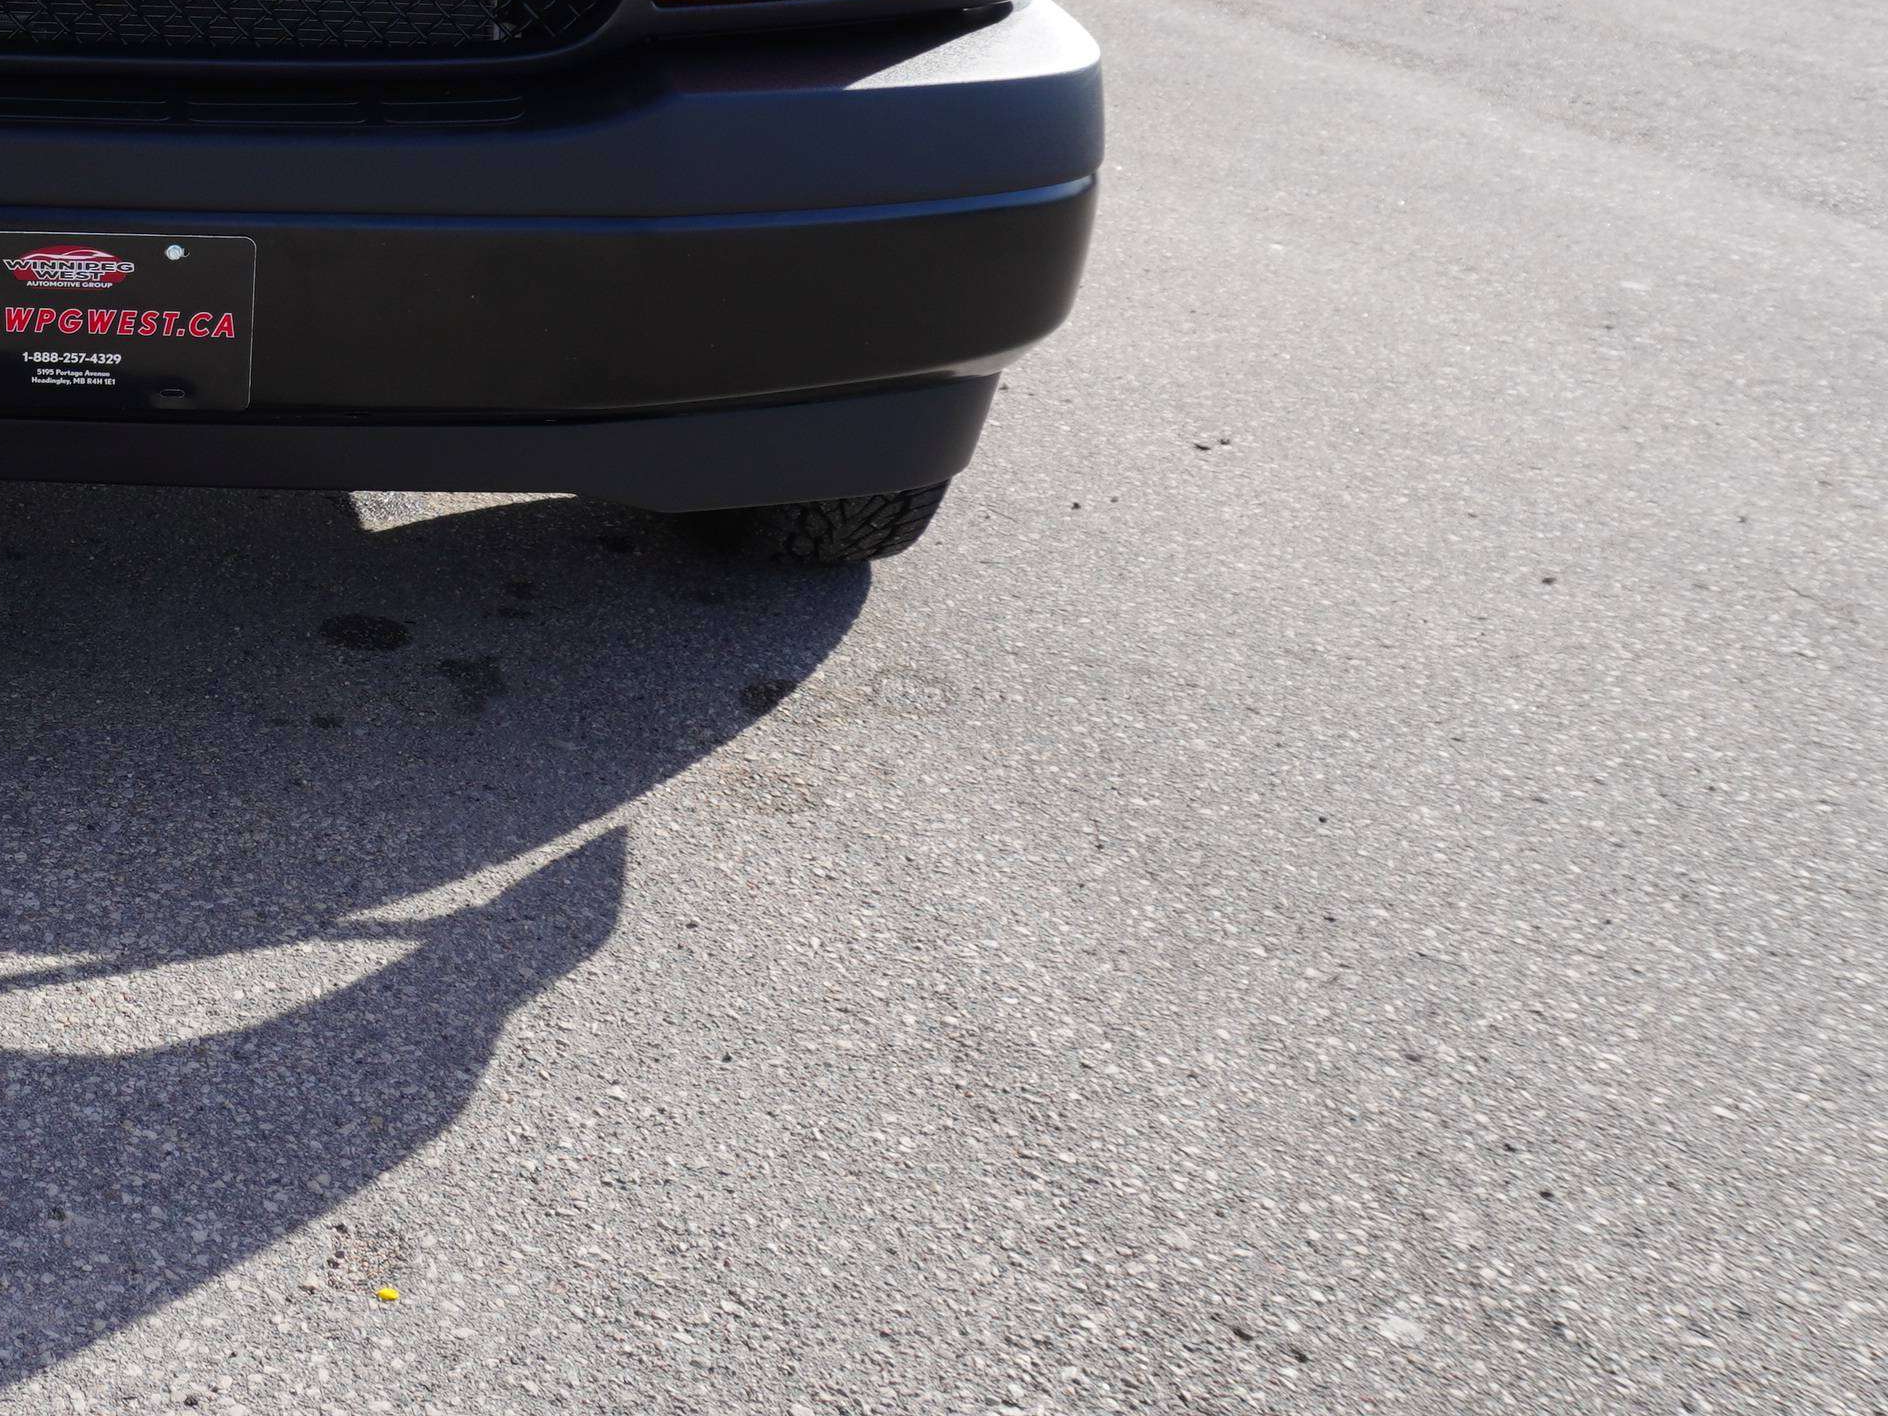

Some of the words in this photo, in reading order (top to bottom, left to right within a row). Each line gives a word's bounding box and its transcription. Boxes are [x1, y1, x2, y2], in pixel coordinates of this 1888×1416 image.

[3, 259, 134, 272] WINNIPEG
[32, 270, 104, 281] WEST
[26, 280, 81, 288] AUTOMOTIVE
[22, 351, 122, 364] 1-888-257-4329
[56, 369, 83, 378] Portage
[31, 376, 72, 385] Headingley,
